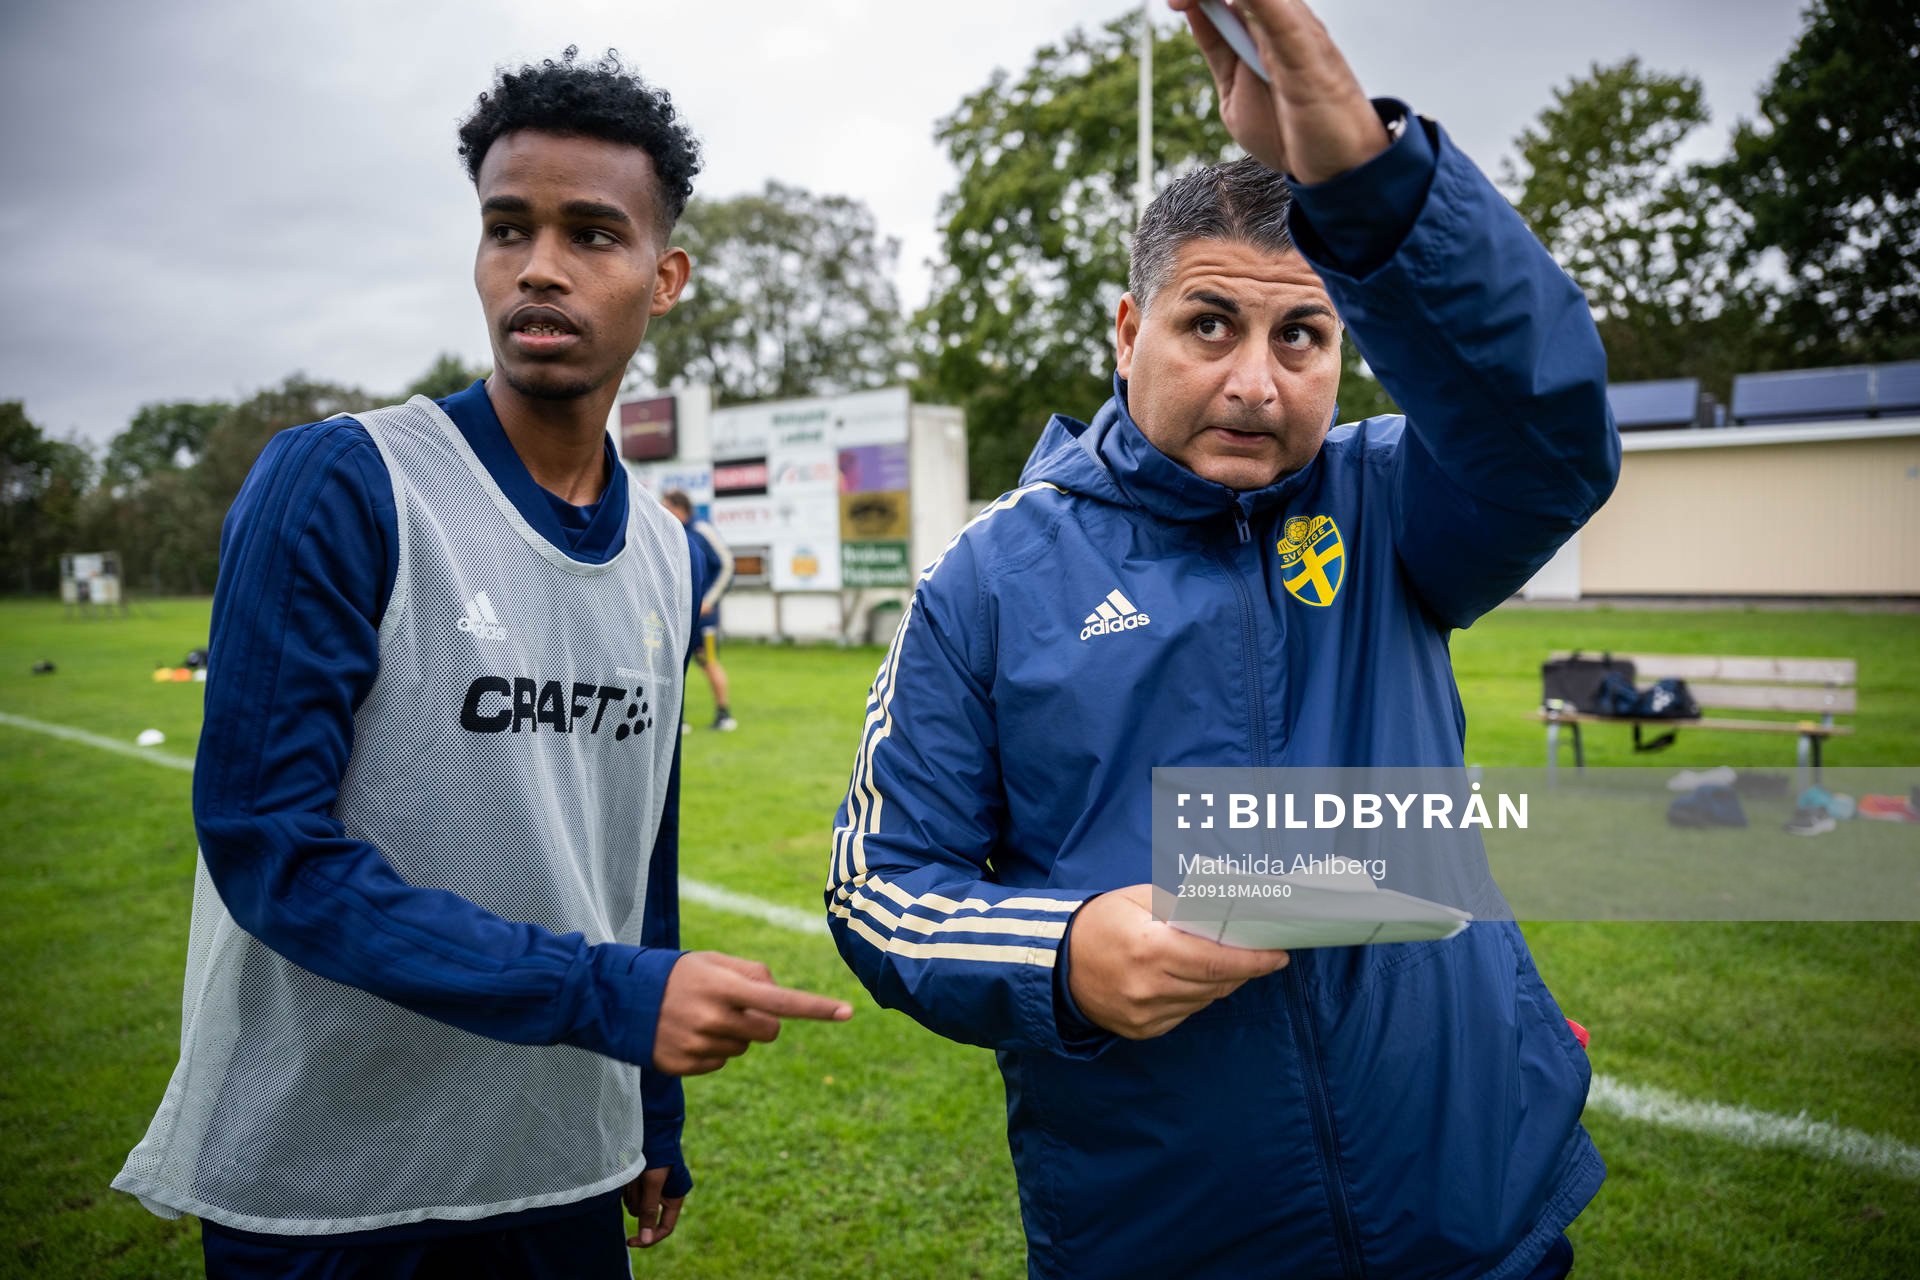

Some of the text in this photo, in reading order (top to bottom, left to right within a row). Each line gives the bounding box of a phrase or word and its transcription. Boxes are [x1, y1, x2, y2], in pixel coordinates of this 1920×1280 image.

[1282, 526, 1326, 563] SVERIGE
[1080, 611, 1151, 641] adidas
[460, 676, 627, 734] CRAFT
